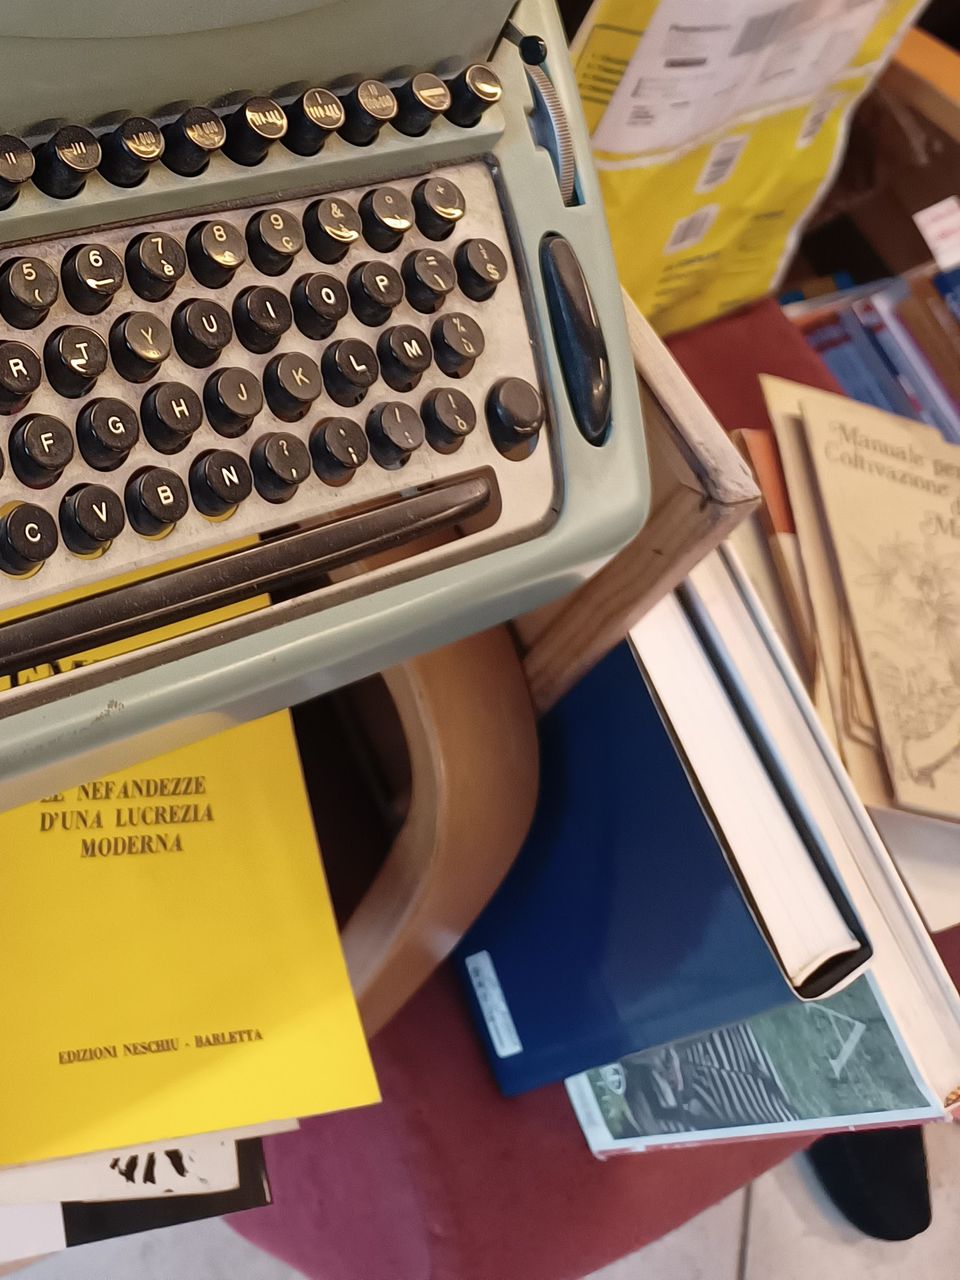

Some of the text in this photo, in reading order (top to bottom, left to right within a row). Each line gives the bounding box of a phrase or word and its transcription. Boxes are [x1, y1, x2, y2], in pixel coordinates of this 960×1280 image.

[22, 263, 37, 280] 5
[89, 250, 103, 267] 6
[151, 238, 163, 254] 7
[213, 225, 227, 242] 8
[270, 213, 284, 230] 9
[331, 202, 344, 219] &
[9, 358, 27, 378] R
[75, 342, 89, 361] T
[141, 327, 153, 345] Y
[202, 315, 218, 333] U
[265, 300, 276, 319] I
[321, 286, 336, 305] O
[376, 274, 389, 294] P
[40, 432, 54, 453] F
[107, 415, 126, 434] G
[171, 401, 190, 418] H
[237, 382, 248, 401] J
[293, 367, 310, 385] K
[349, 353, 368, 373] L
[403, 339, 423, 359] M
[24, 523, 41, 542] C
[92, 501, 107, 522] V
[157, 486, 175, 504] B
[222, 466, 240, 485] N
[77, 775, 206, 802] NEFANDEZZE
[40, 803, 215, 832] D'UNA LUCREZIA
[81, 833, 183, 858] MODERNA
[58, 1045, 118, 1065] EDIZIONI
[194, 1028, 264, 1049] BARLETTA
